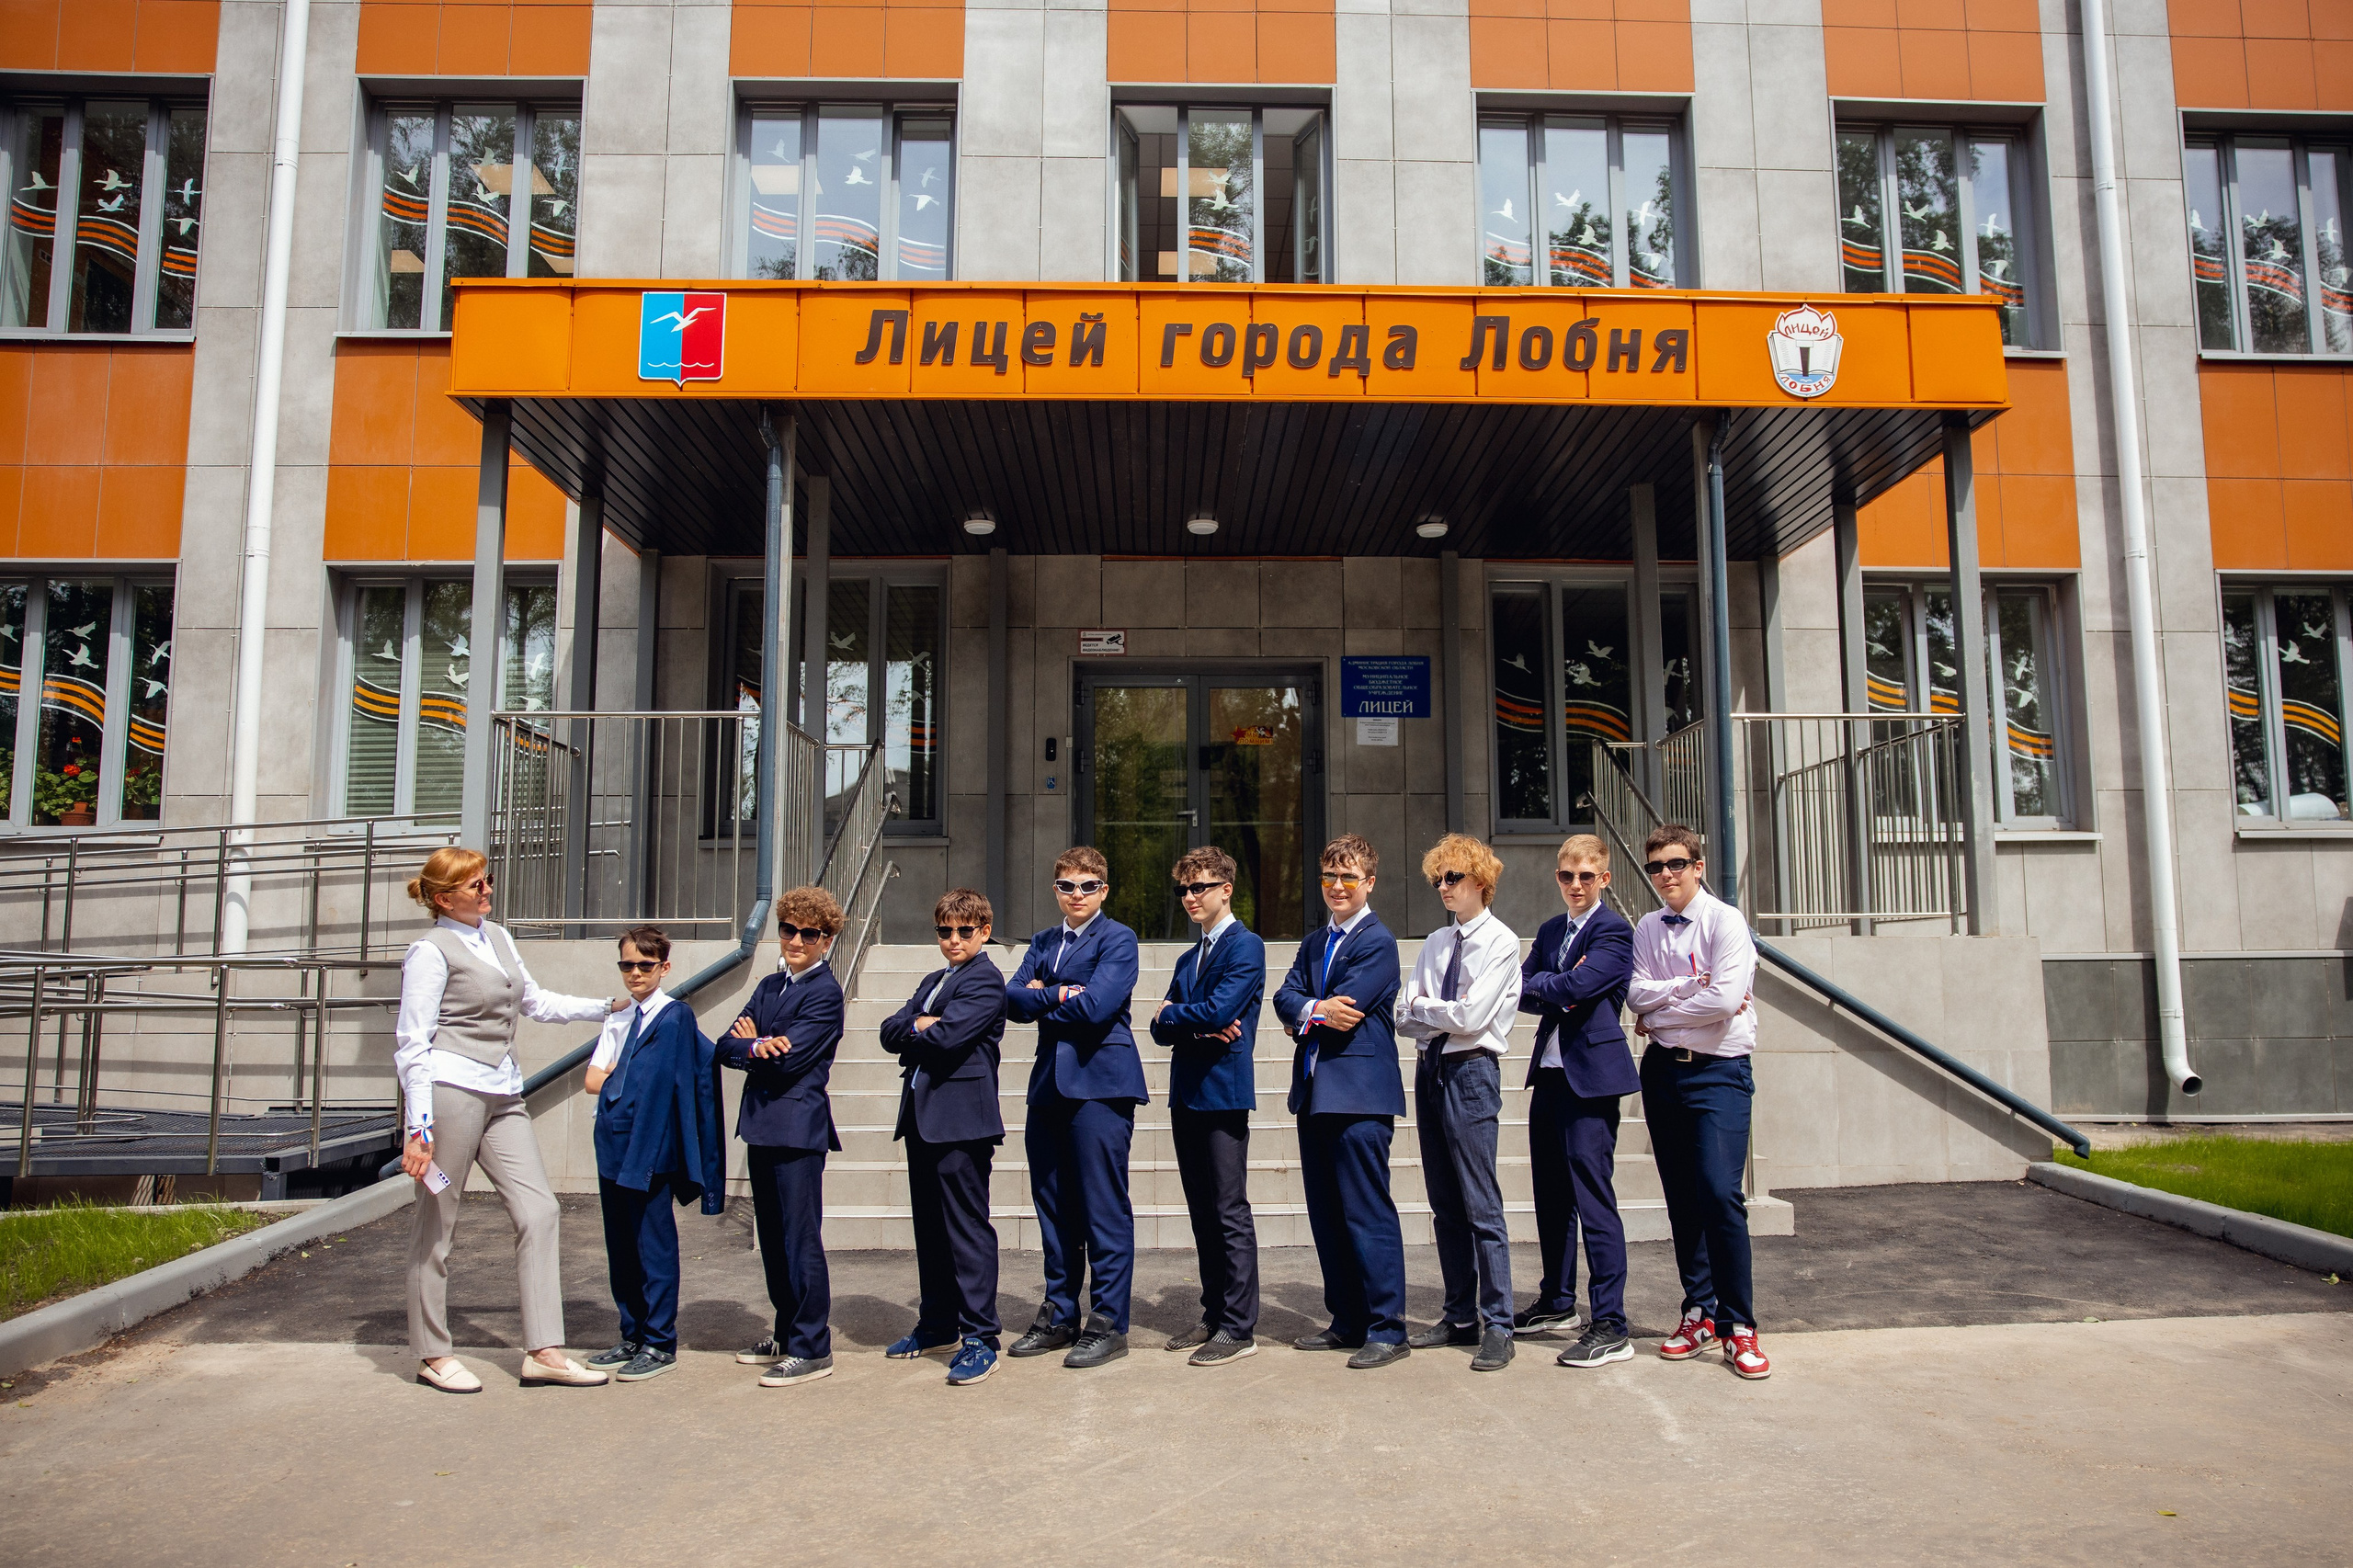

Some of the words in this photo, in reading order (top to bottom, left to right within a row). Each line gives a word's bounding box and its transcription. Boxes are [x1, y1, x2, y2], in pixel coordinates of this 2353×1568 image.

[855, 309, 1108, 373] Лицей
[1160, 322, 1419, 378] города
[1460, 315, 1689, 372] Лобня
[1780, 375, 1831, 392] ЛОБНЯ
[1358, 699, 1414, 714] ЛИЦЕЙ
